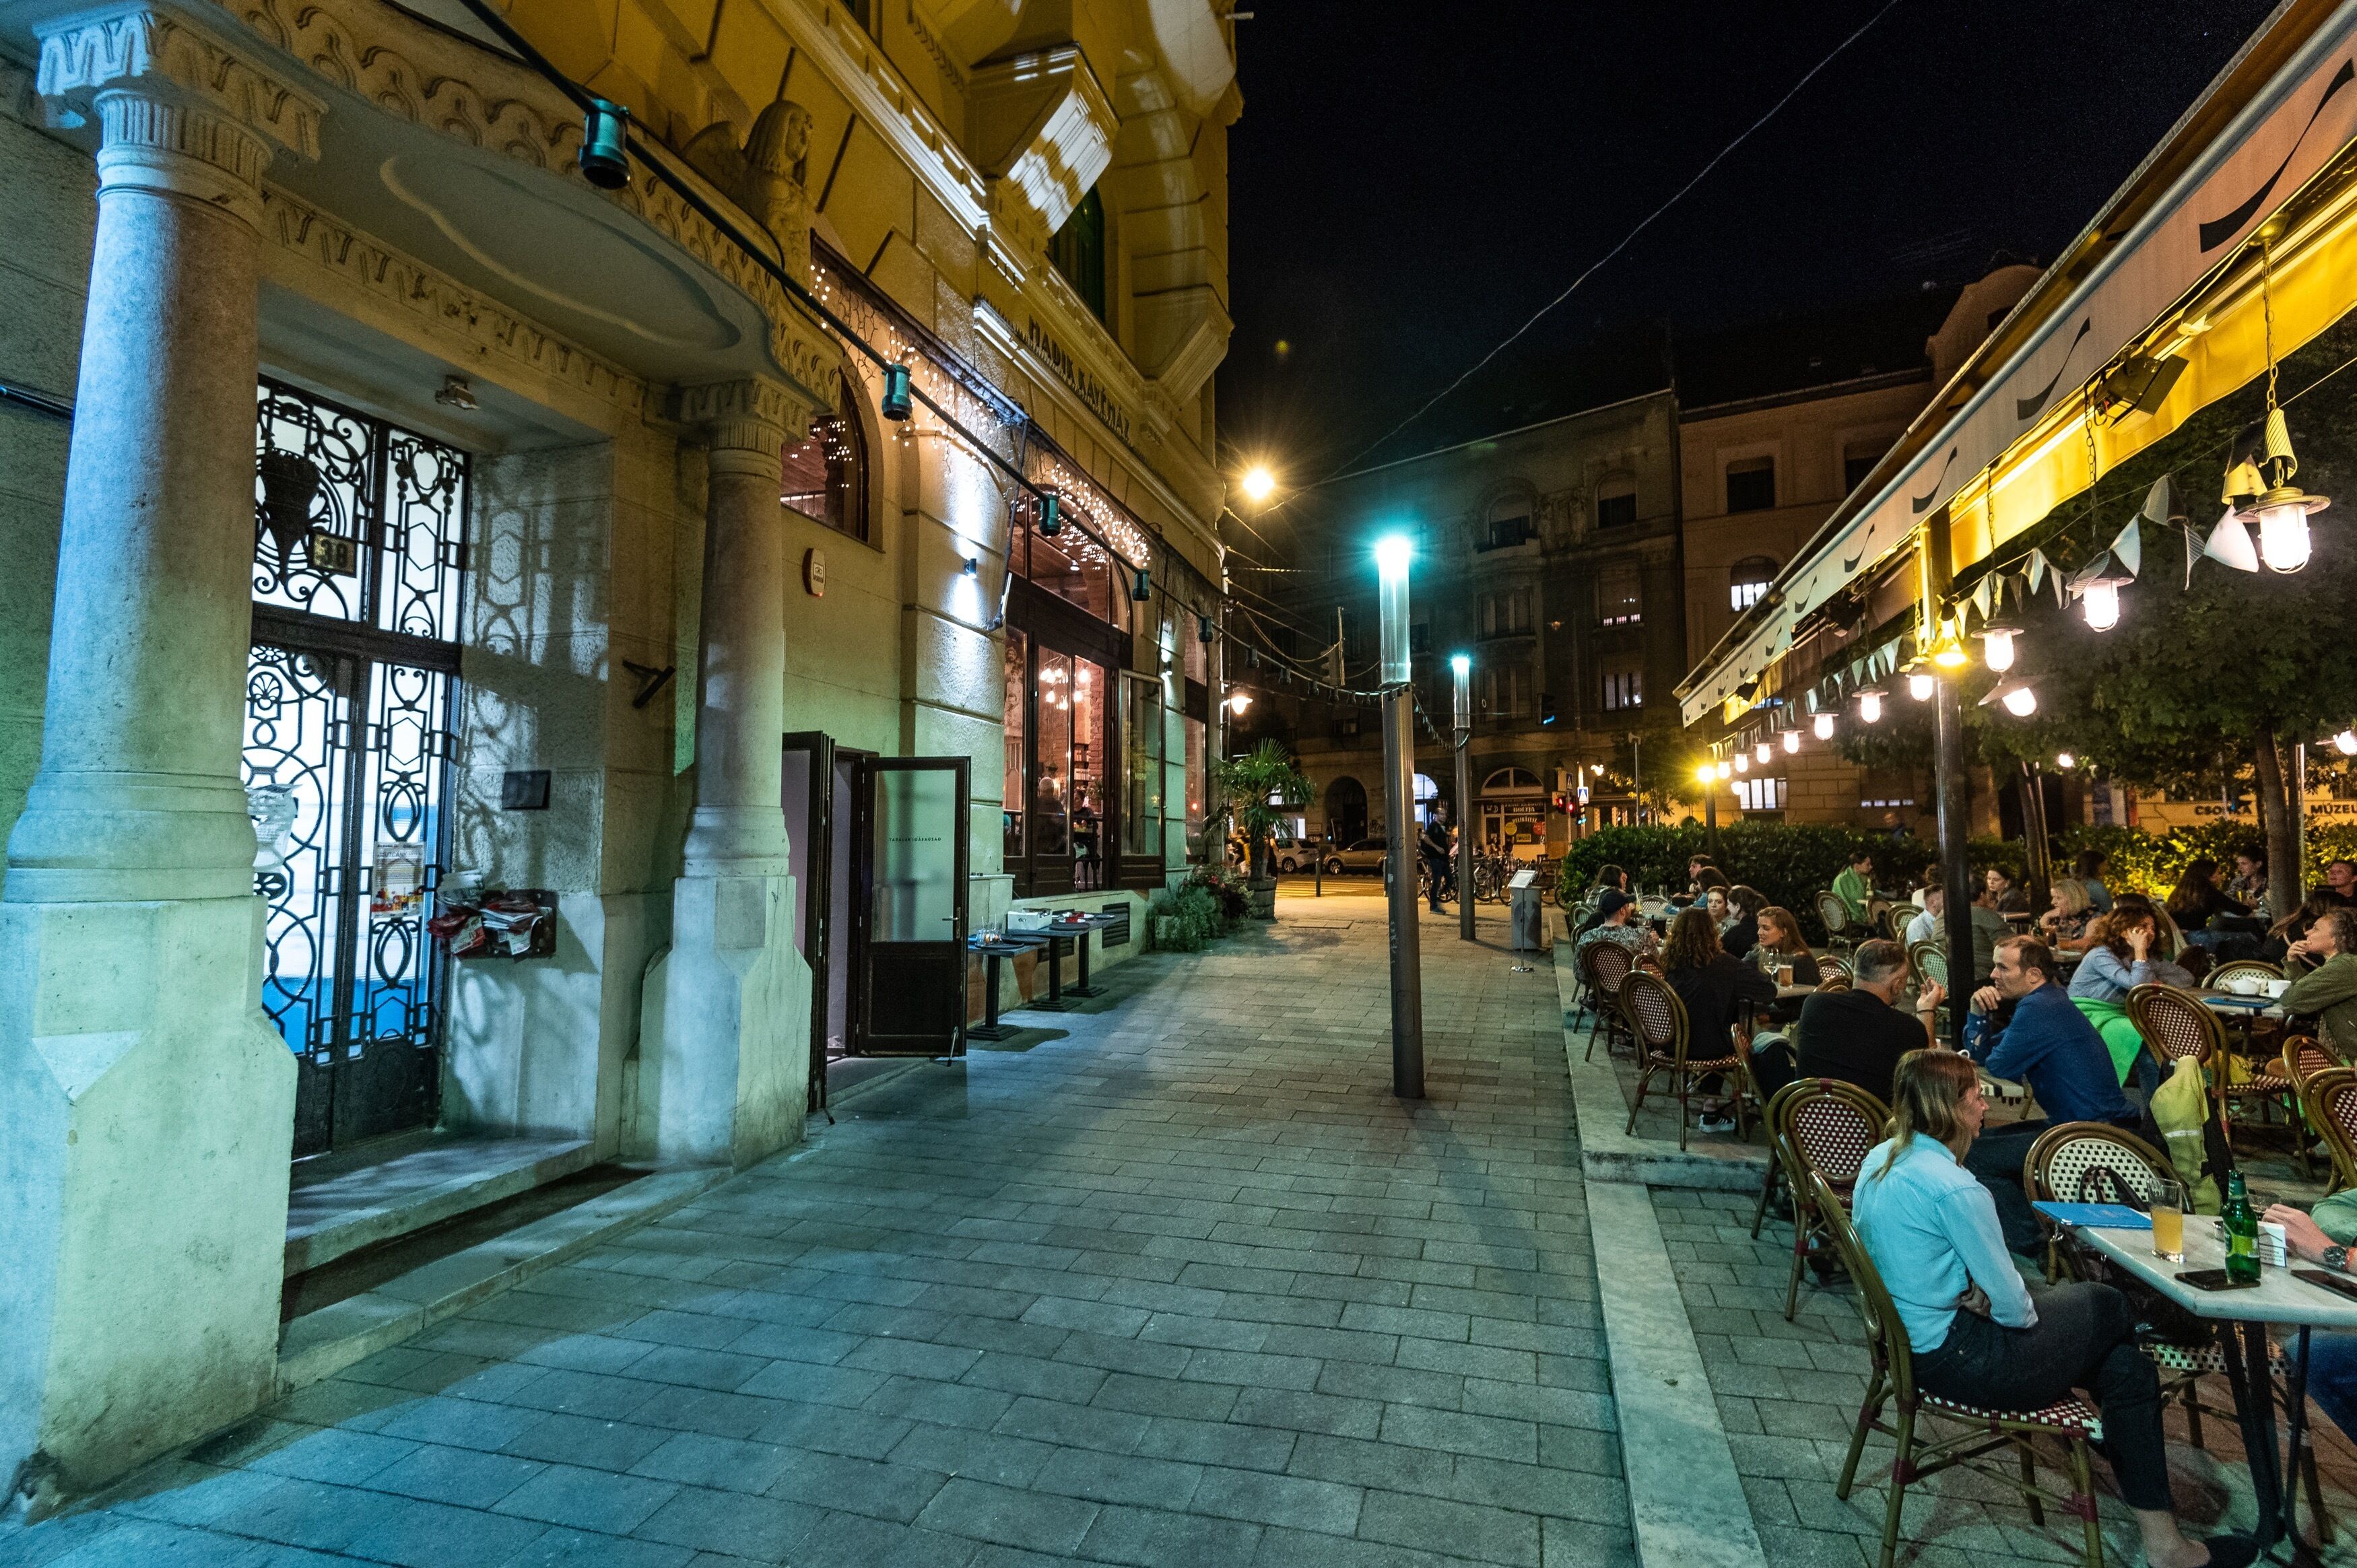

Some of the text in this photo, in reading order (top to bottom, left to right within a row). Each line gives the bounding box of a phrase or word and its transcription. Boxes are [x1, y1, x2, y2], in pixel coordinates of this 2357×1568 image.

[1029, 314, 1075, 388] HADIK
[321, 539, 348, 568] 38
[2195, 806, 2252, 815] CSOA
